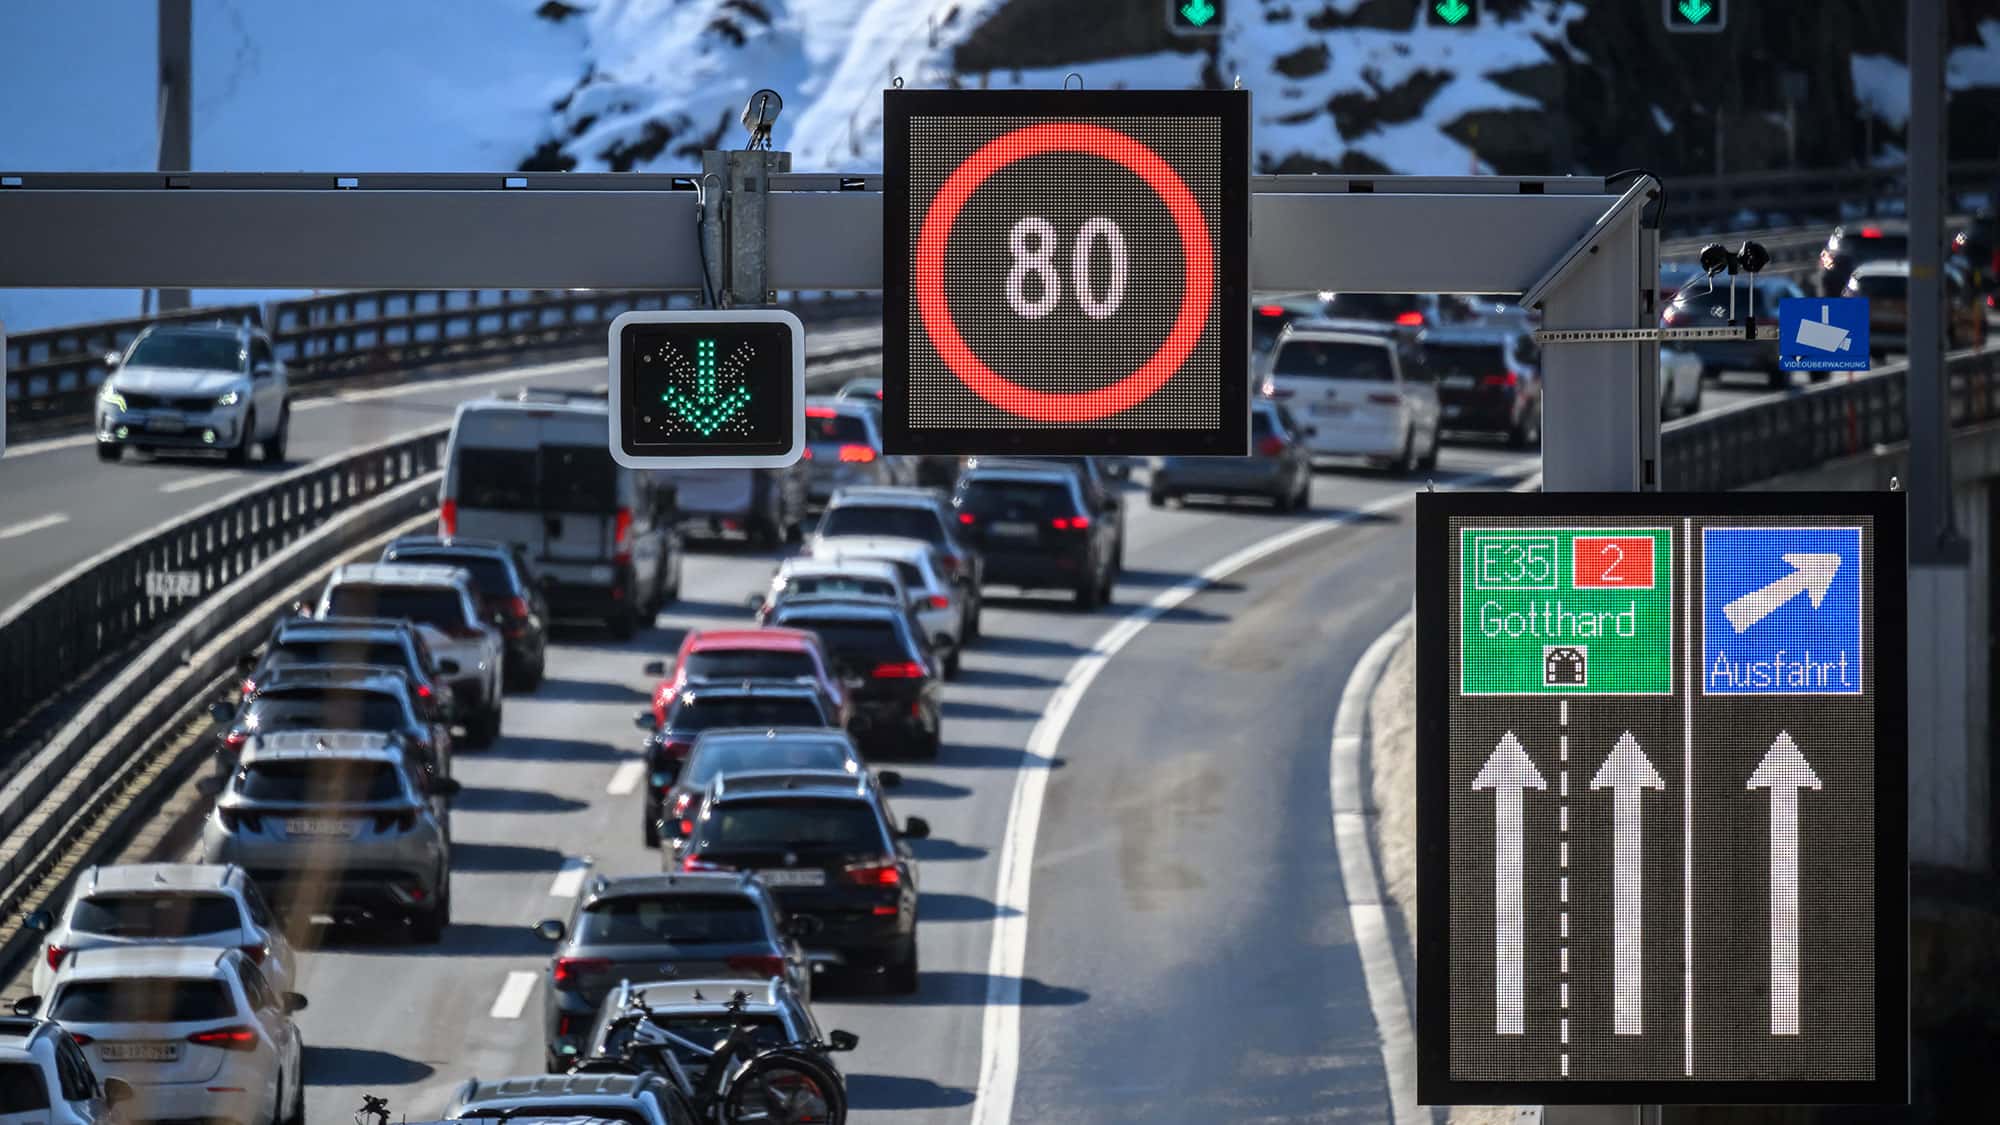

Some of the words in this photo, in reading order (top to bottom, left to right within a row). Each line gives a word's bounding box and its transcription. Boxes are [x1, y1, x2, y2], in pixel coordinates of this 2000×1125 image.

[1007, 217, 1127, 319] 80
[1784, 360, 1866, 368] VIDEOÜBERWACHUNG
[1482, 544, 1550, 581] E35
[1600, 544, 1624, 581] 2
[1480, 600, 1635, 637] Gotthard
[1711, 650, 1851, 688] Ausfahrt
